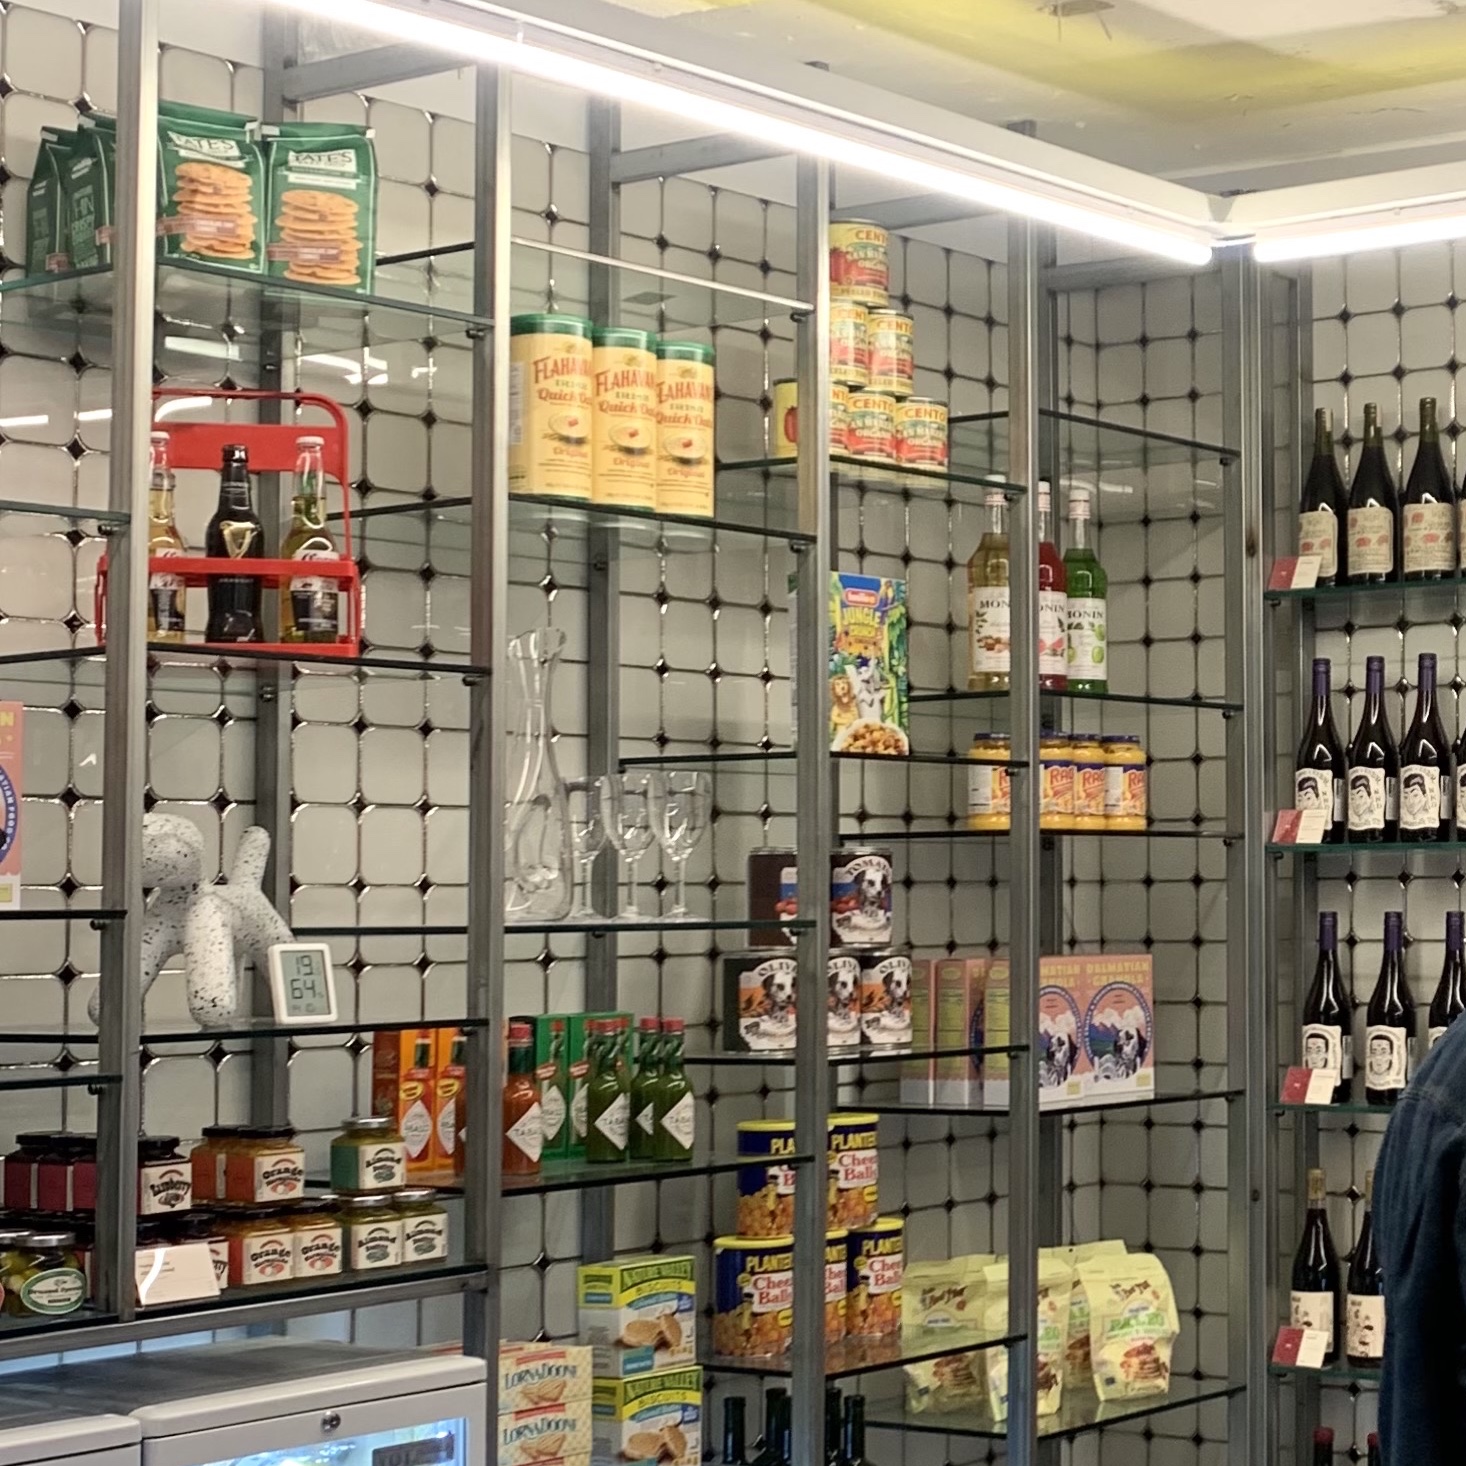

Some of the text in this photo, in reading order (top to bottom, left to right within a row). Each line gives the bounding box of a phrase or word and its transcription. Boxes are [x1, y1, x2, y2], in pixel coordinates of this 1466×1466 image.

[855, 229, 888, 244] CENT
[852, 398, 896, 414] CENTO
[904, 406, 948, 421] CENTO
[980, 600, 1010, 609] MON
[295, 954, 314, 977] 19
[290, 978, 316, 999] 64
[831, 1131, 878, 1151] PLANTE
[862, 1236, 902, 1255] PLANTE
[745, 1252, 794, 1273] PLANTE
[752, 1275, 793, 1291] Chee
